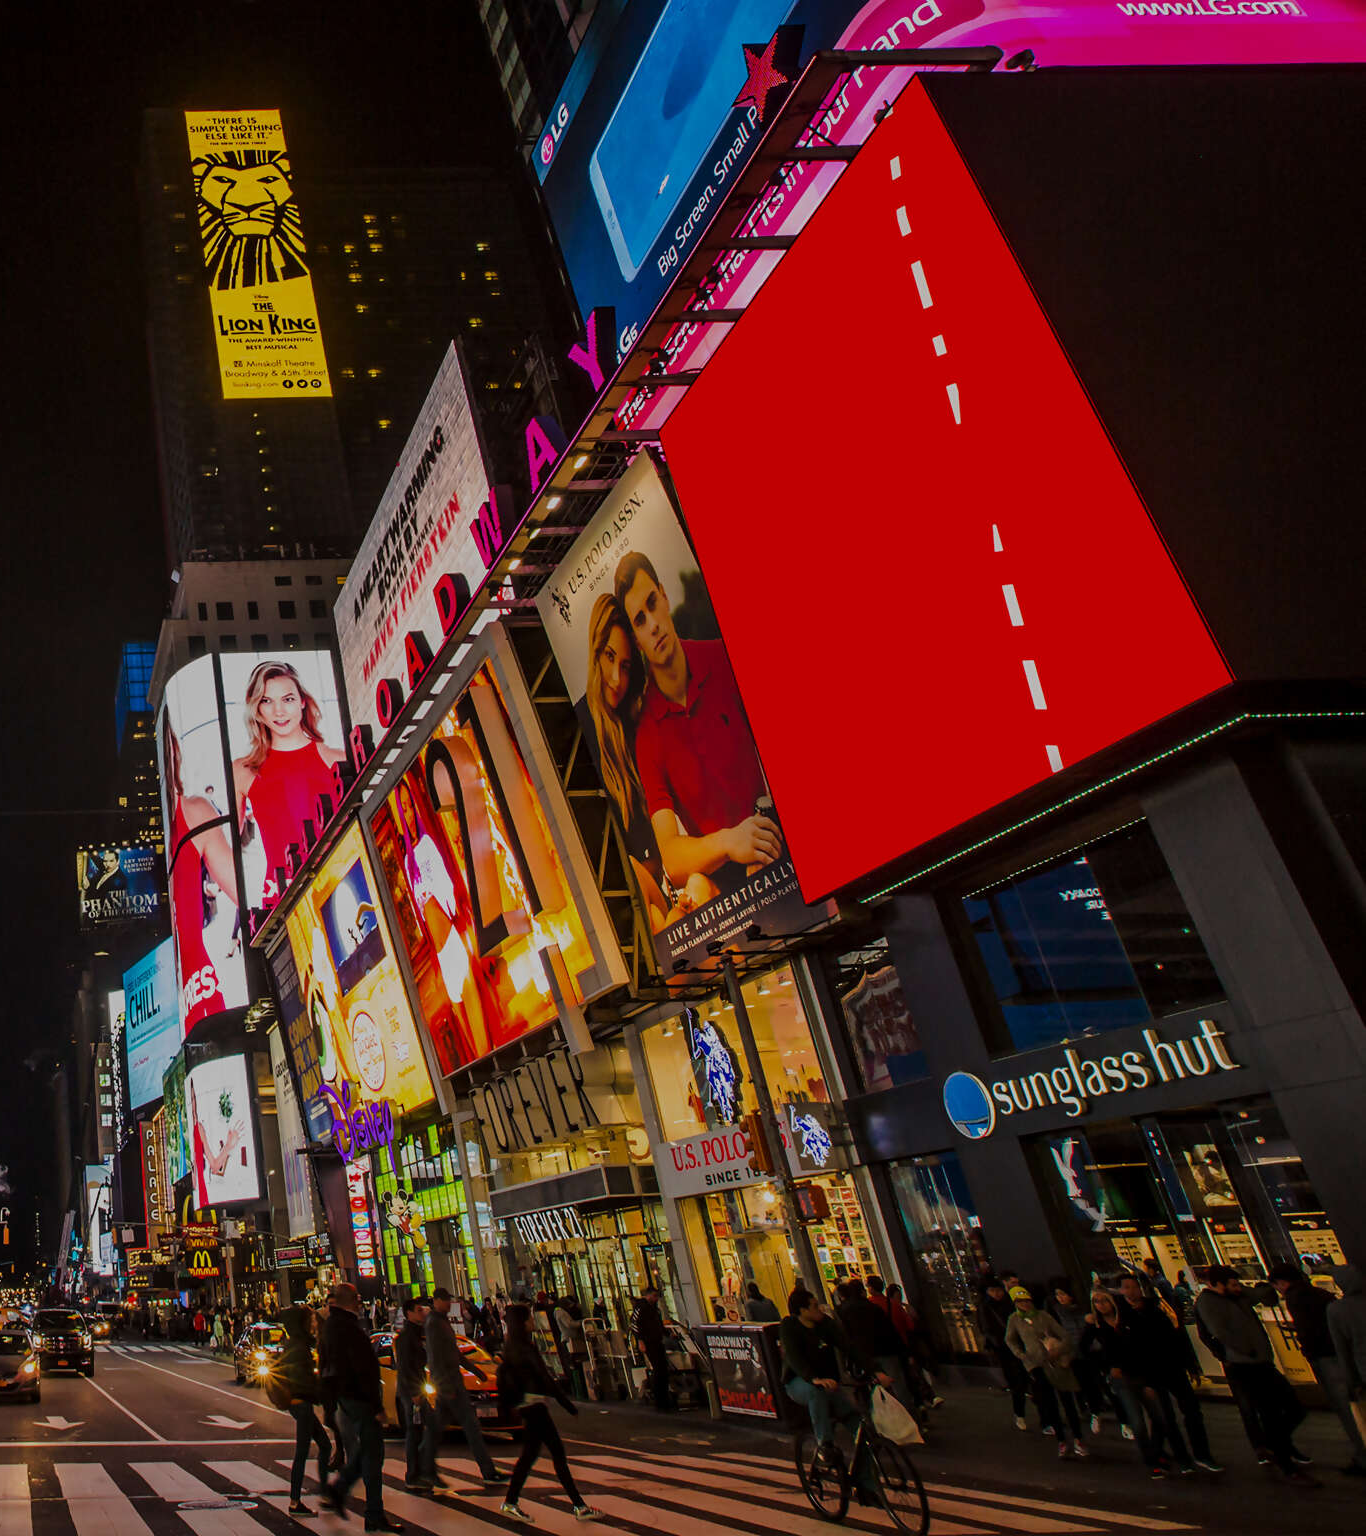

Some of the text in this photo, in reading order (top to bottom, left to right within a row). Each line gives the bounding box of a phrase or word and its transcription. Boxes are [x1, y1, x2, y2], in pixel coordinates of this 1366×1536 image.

[1117, 0, 1302, 16] www.LG.com
[189, 124, 282, 133] SIMPLY NOTHING
[205, 132, 228, 140] ELSE
[232, 132, 253, 140] LIKE
[550, 102, 570, 143] LG
[657, 244, 679, 277] Big
[675, 184, 717, 250] Screen.
[713, 121, 752, 186] Small
[252, 302, 275, 311] THE
[568, 493, 652, 604] U.S. POLO ASSN.
[362, 599, 401, 683] HARVEY
[81, 891, 159, 916] PHANTOM
[108, 889, 127, 899] THE
[121, 904, 153, 916] OPERA
[666, 860, 797, 946] LIVE AUTHENTICALLY
[129, 982, 161, 1029] CHILL.
[990, 1019, 1241, 1118] sunglass hut
[468, 1045, 602, 1150] FOREVER
[670, 1140, 701, 1174] U.S.
[700, 1130, 749, 1168] POLO
[145, 1129, 161, 1221] PALACE
[705, 1168, 741, 1186] SINCE
[513, 1205, 587, 1247] FOREVER 21
[706, 1335, 752, 1349] BROADWAY'S
[709, 1346, 728, 1360] SURE
